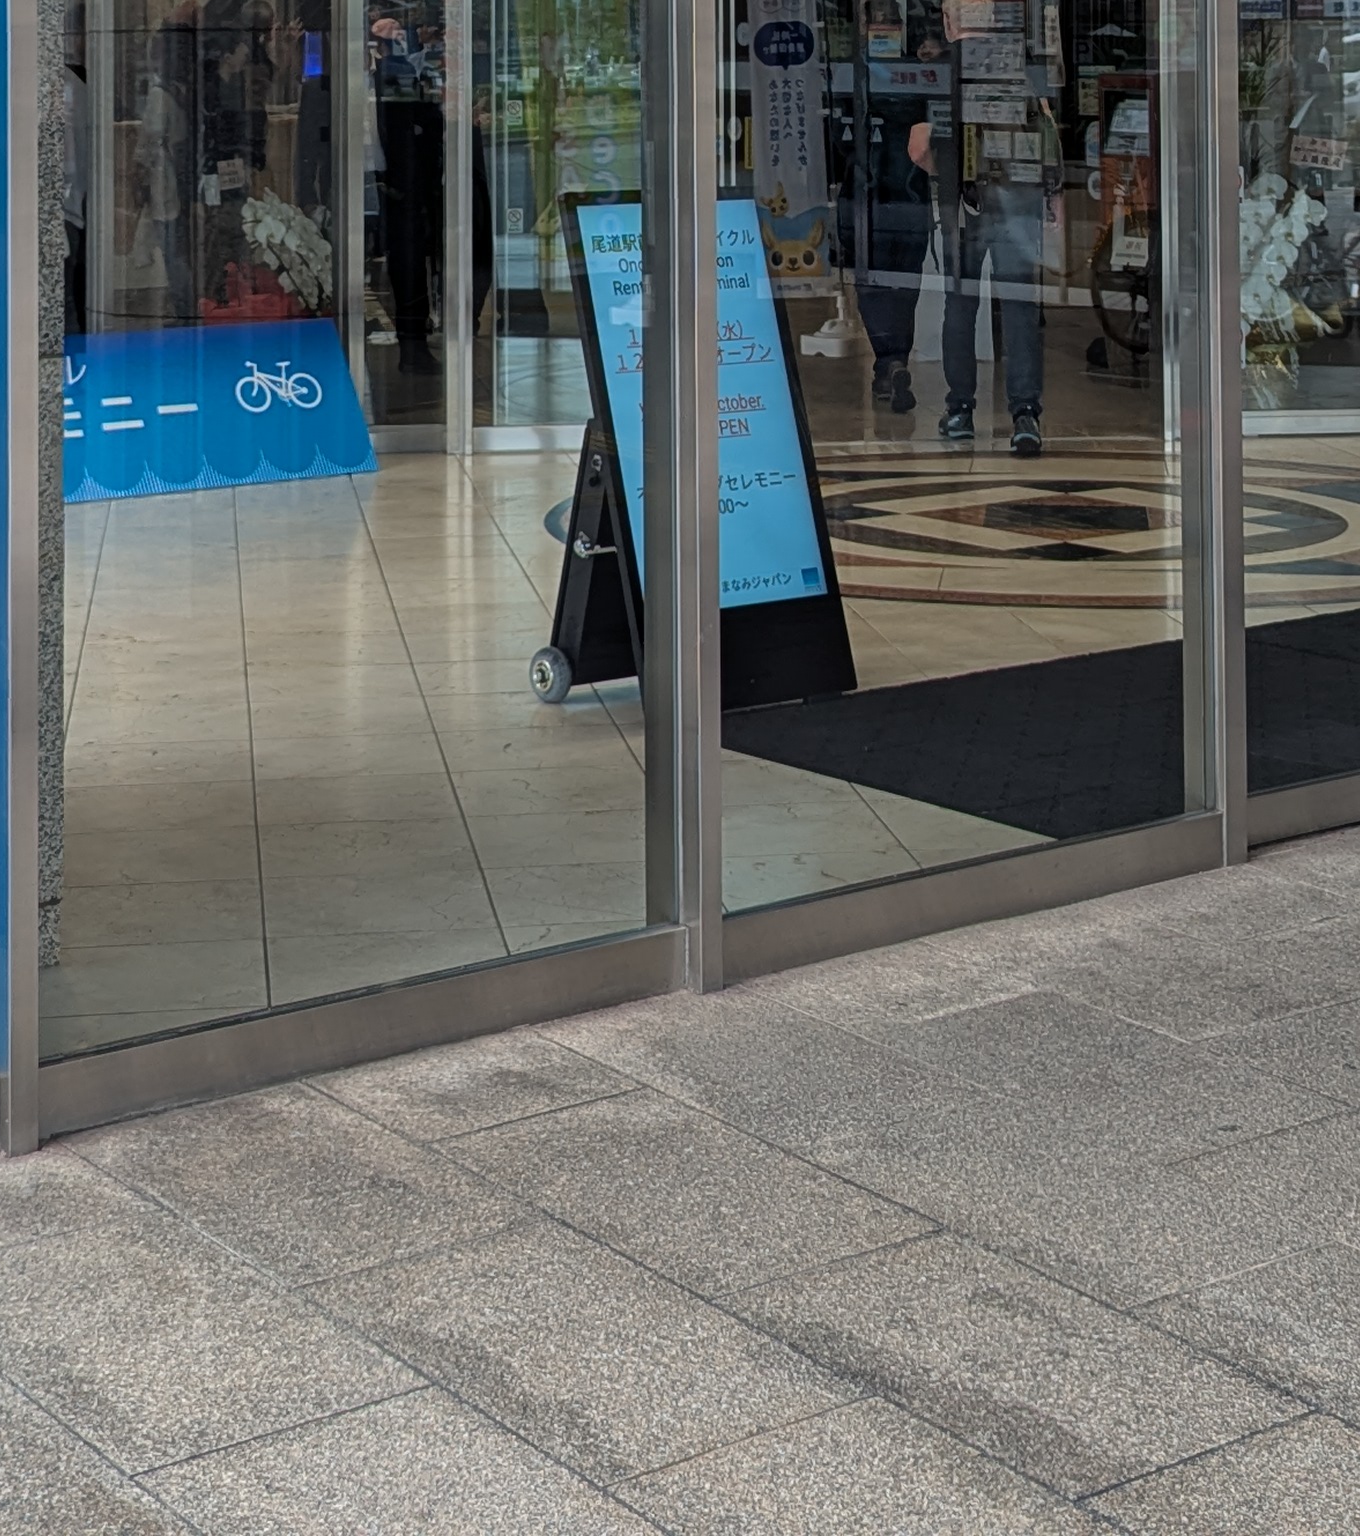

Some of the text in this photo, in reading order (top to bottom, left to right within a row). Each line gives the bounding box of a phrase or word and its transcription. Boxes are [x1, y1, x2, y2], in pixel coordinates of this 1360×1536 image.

[718, 417, 750, 436] PEN
[721, 571, 792, 593] まなみジャパン
